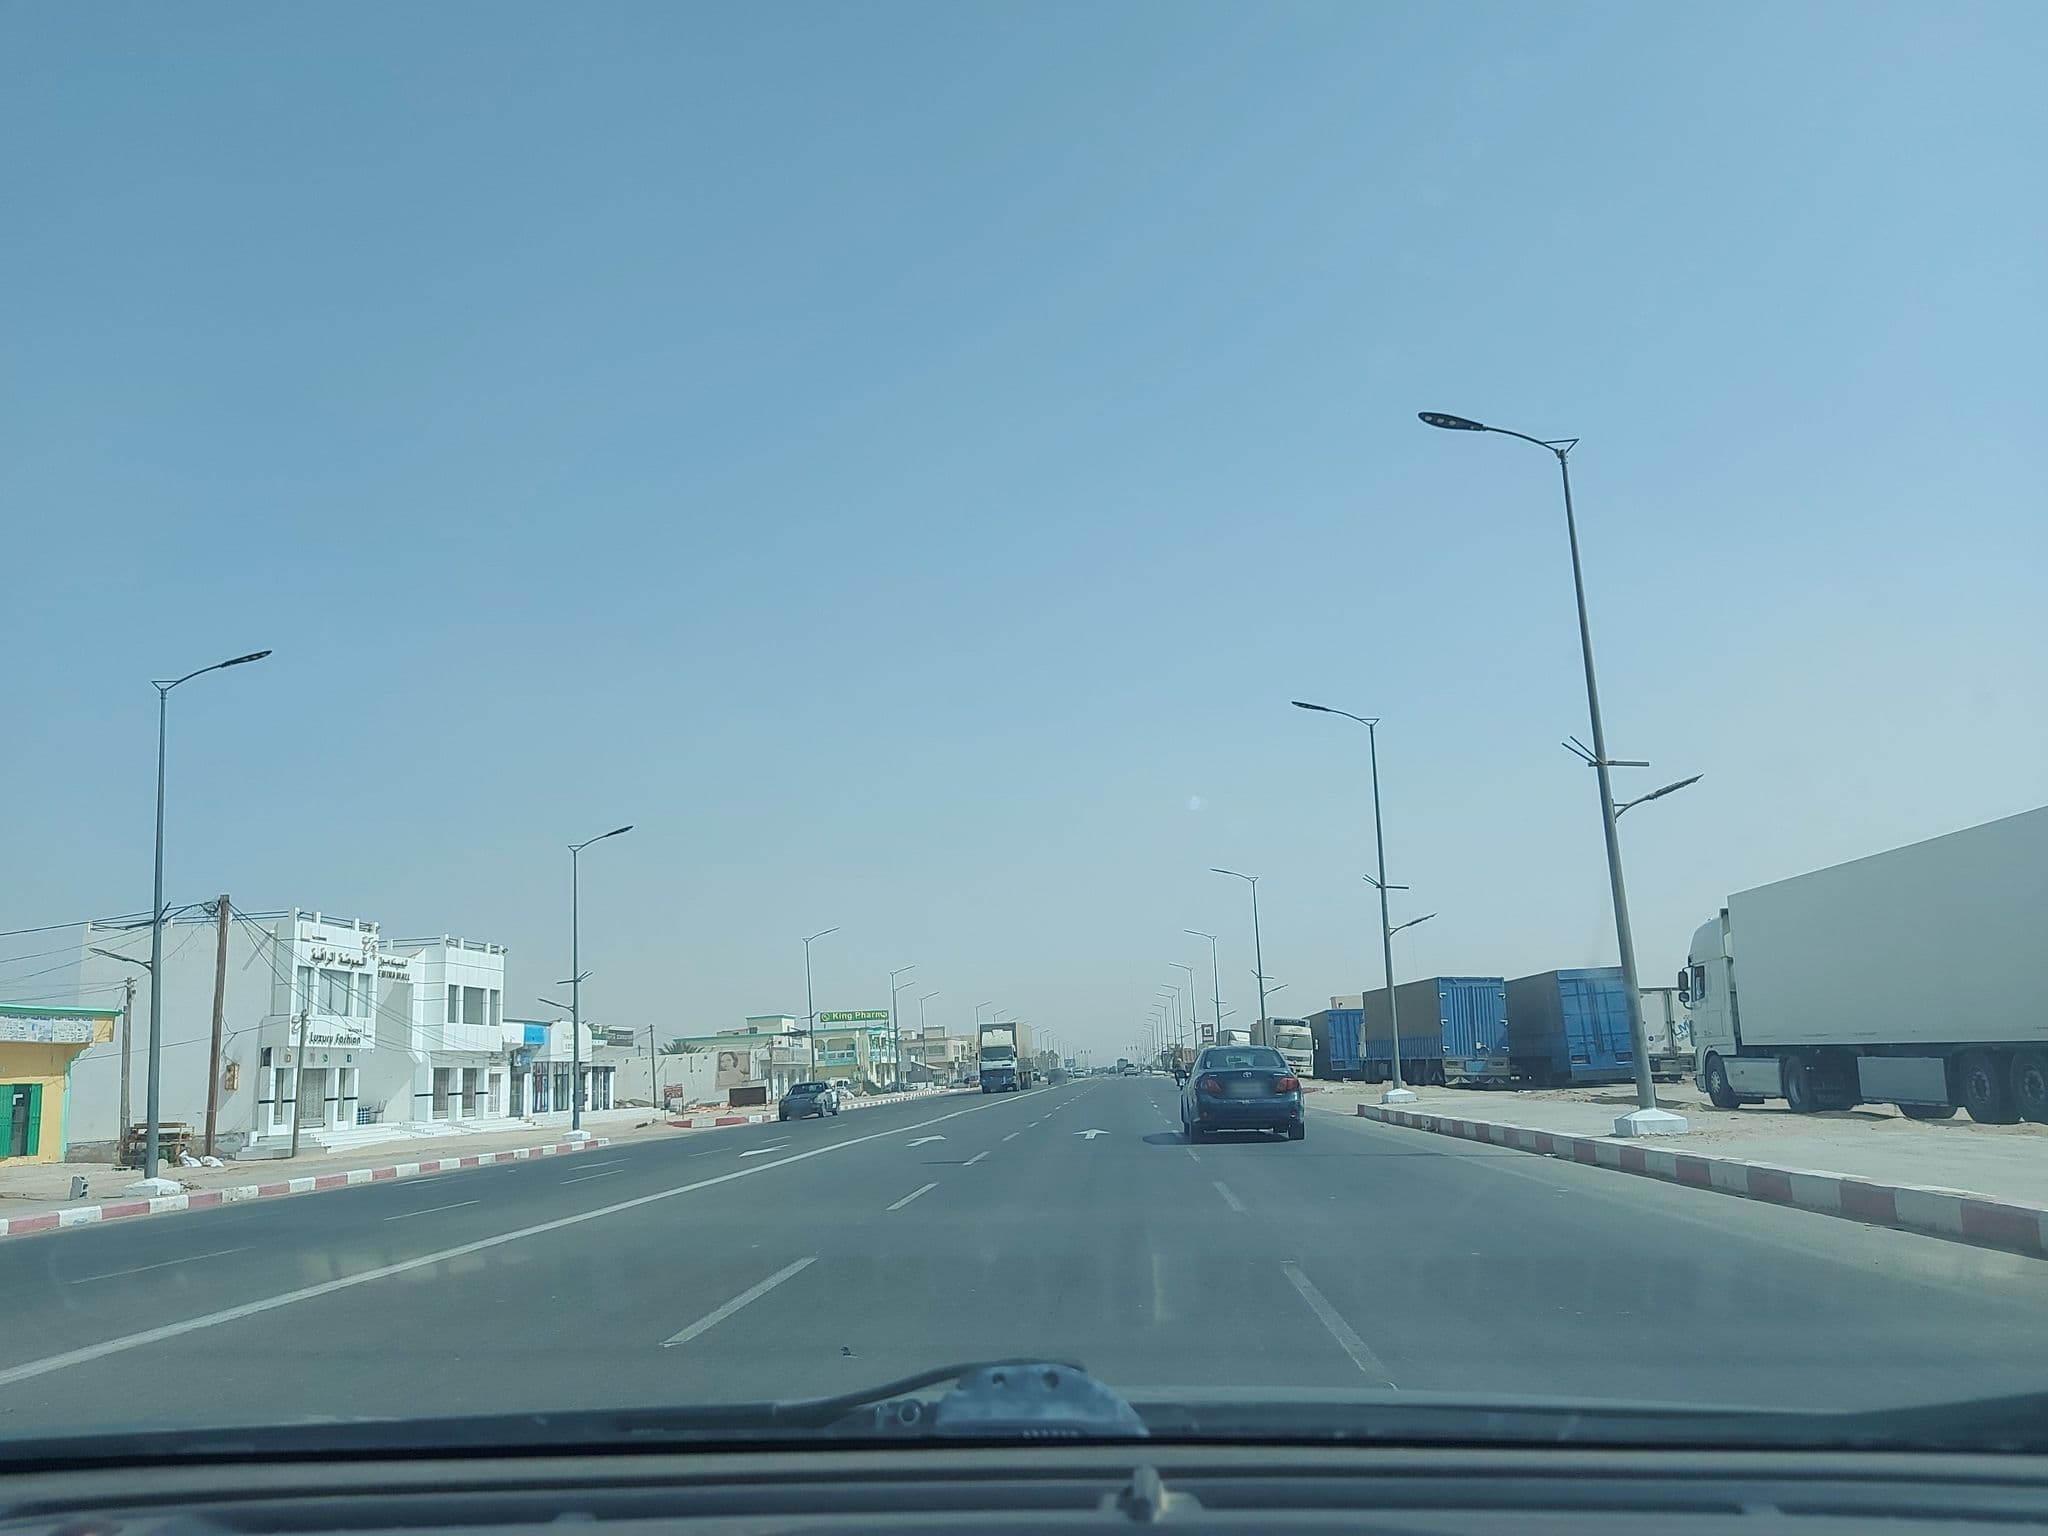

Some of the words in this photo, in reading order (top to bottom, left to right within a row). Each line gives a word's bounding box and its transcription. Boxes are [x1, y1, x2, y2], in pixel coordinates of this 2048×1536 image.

[833, 1012, 853, 1021] King
[855, 1011, 887, 1020] Pharma
[310, 1031, 334, 1045] Luxury
[335, 1033, 361, 1045] Fashion
